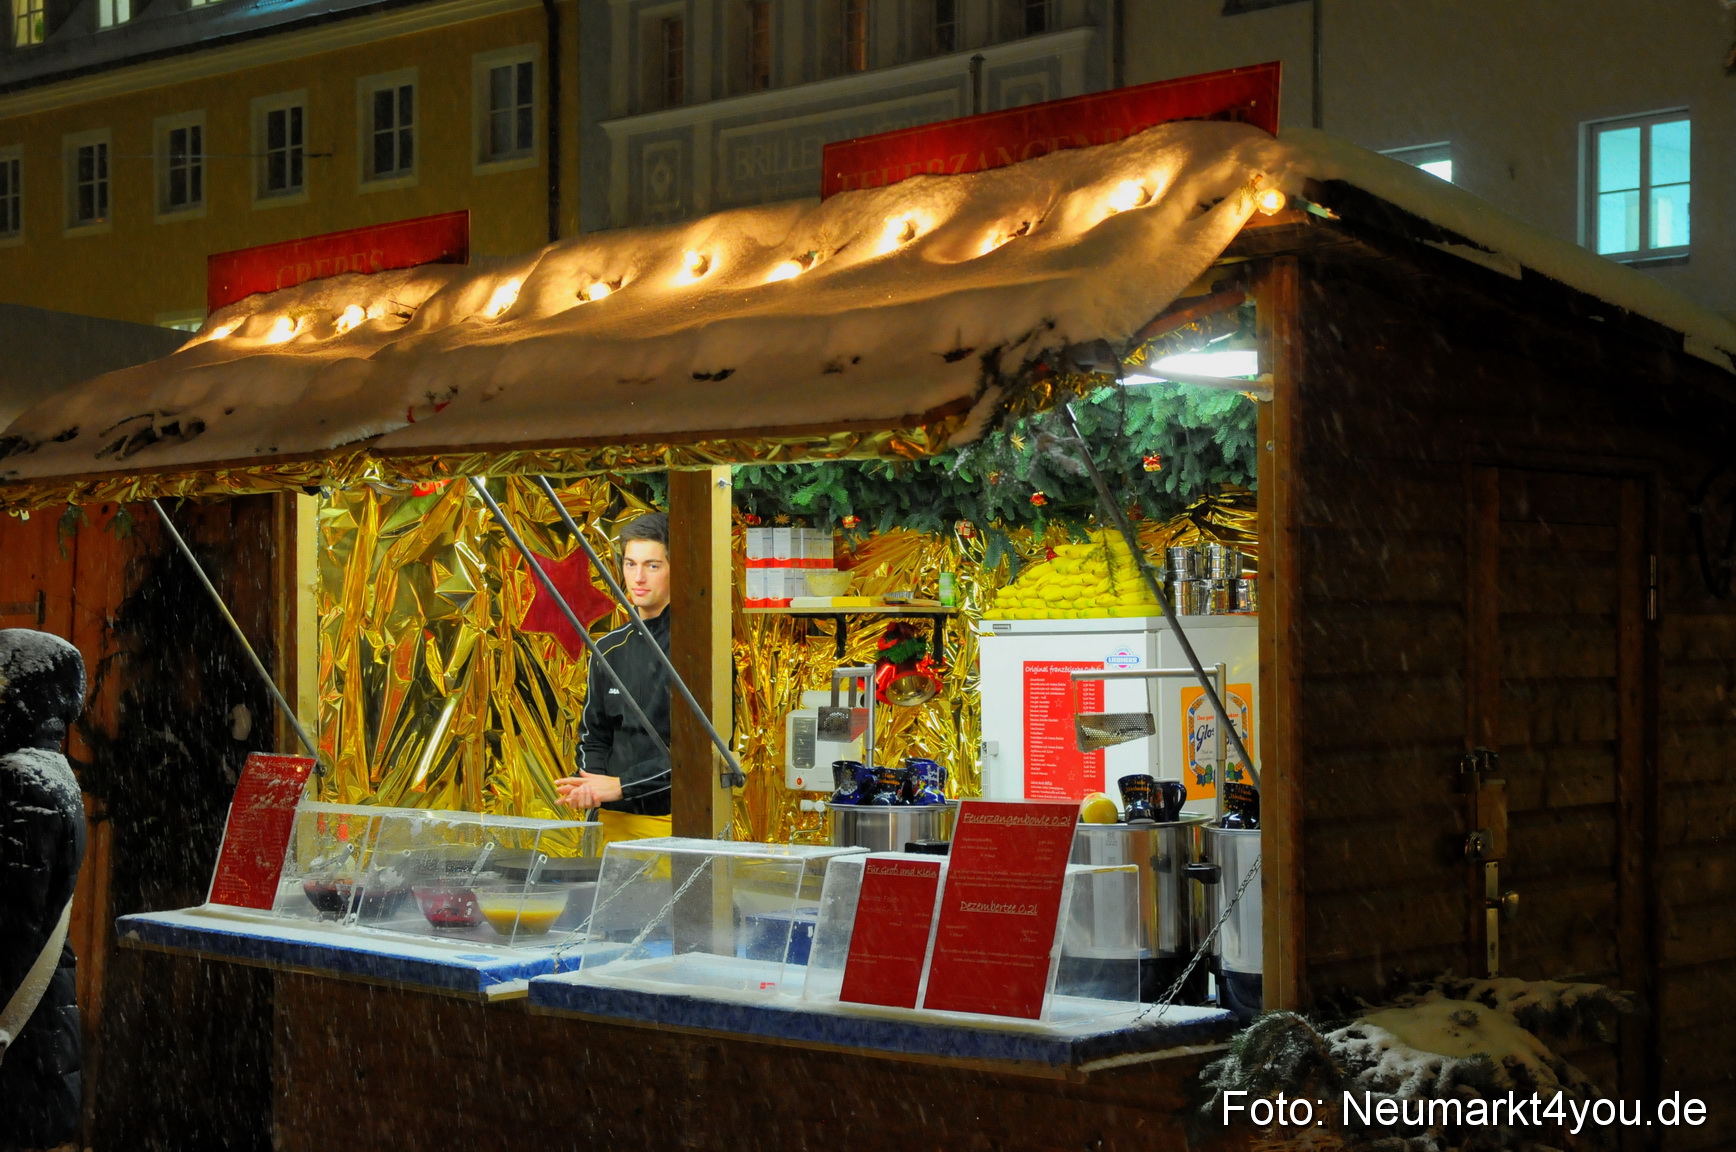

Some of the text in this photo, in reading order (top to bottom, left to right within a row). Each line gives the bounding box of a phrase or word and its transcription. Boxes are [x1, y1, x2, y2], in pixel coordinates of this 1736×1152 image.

[1025, 665, 1048, 675] Original
[963, 812, 1050, 827] Feuerzangenbowle
[866, 863, 937, 877] Für Groß und Klein
[960, 900, 1017, 913] Dezembertee
